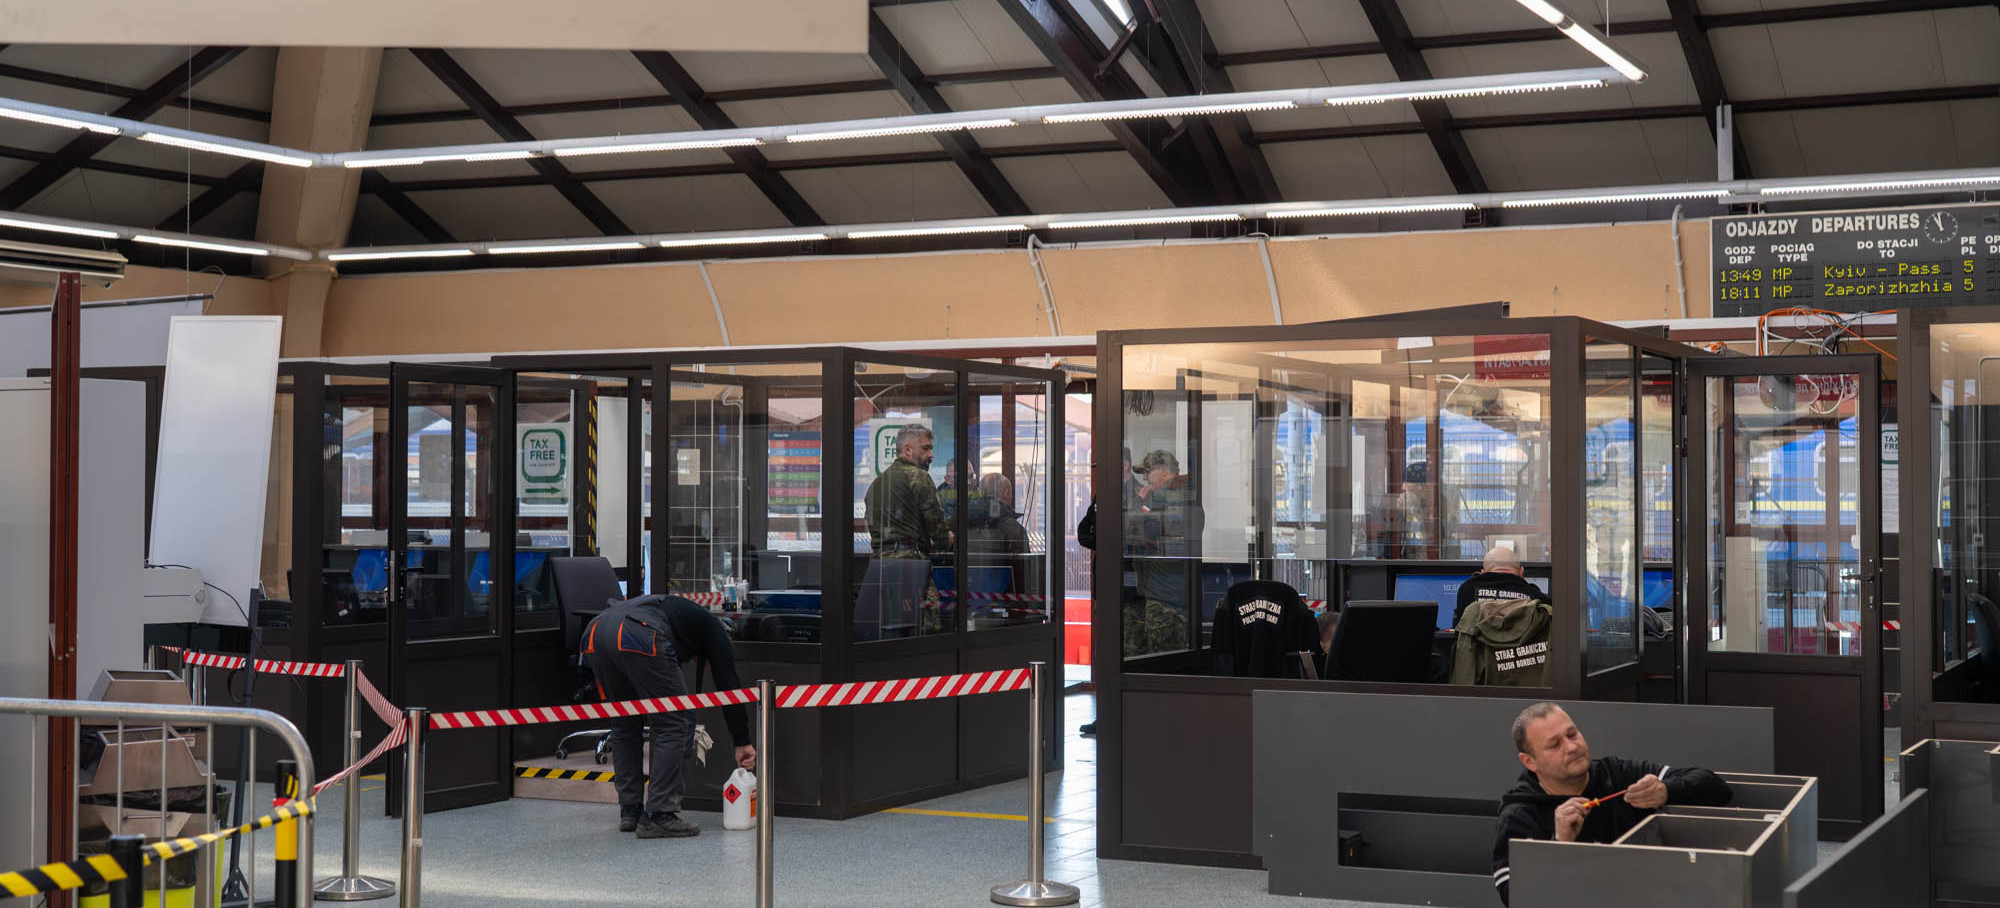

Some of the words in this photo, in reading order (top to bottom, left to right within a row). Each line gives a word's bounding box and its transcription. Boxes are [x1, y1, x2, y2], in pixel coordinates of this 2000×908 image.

[1725, 219, 1798, 237] ODJAZDY
[1812, 213, 1920, 233] DEPARTURES
[1857, 241, 1873, 249] DO
[1877, 238, 1919, 248] STACJI
[1961, 236, 1977, 245] PE
[1724, 246, 1756, 255] GODZ
[1770, 243, 1815, 254] POCIĄG
[1879, 249, 1896, 258] TO
[1961, 246, 1977, 255] PL
[1729, 256, 1752, 264] DEP
[1778, 253, 1808, 262] TYPE
[1720, 268, 1762, 283] 13:49
[1773, 267, 1793, 281] MP
[1824, 264, 1866, 278] Kyiv
[1898, 262, 1941, 276] Pass
[1963, 259, 1974, 273] 5
[1720, 285, 1761, 300] 18:11
[1772, 285, 1793, 298] MP
[1824, 279, 1952, 296] Zaporizhzhia
[1963, 277, 1974, 291] 5
[530, 439, 548, 449] TAX
[884, 435, 897, 447] TA
[530, 450, 556, 460] FREE
[1497, 661, 1515, 672] POLISH
[1516, 657, 1537, 668] BORDER
